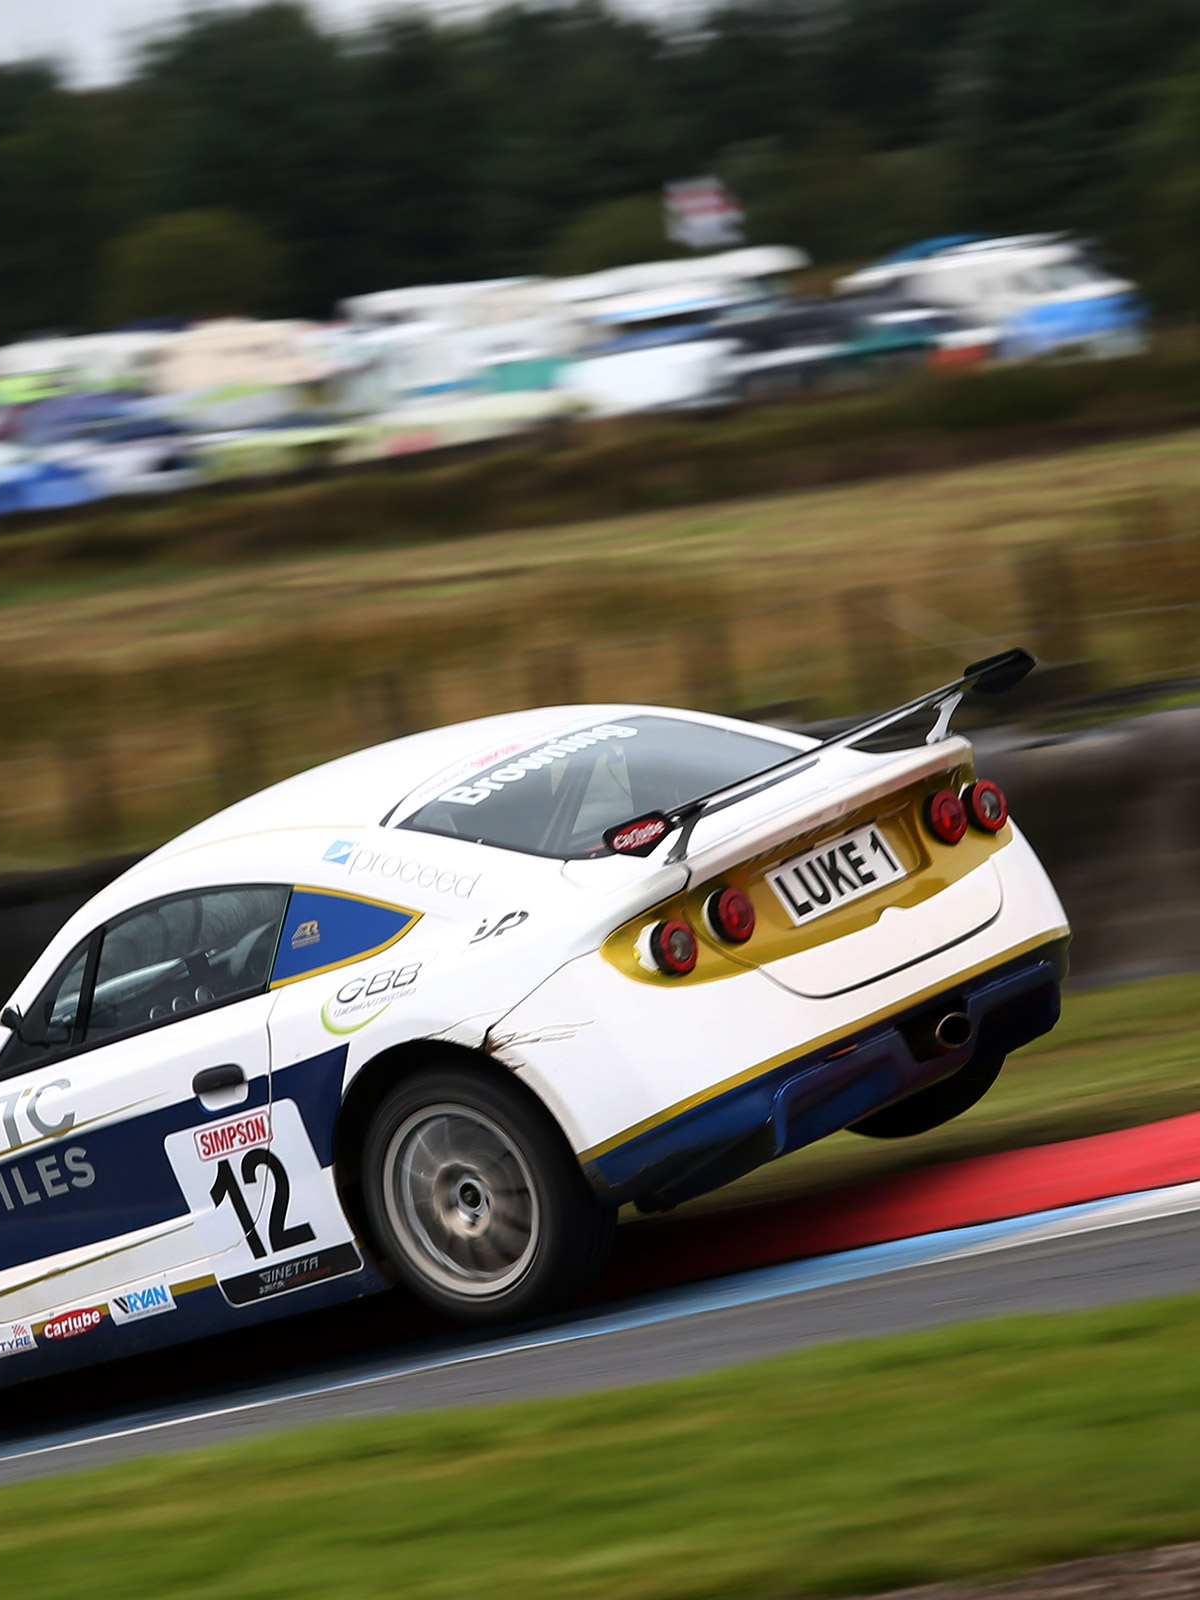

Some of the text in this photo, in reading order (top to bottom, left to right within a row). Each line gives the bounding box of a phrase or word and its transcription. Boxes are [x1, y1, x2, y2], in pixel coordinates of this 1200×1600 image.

[437, 724, 639, 806] Browning
[347, 848, 482, 899] proceed
[773, 829, 899, 918] LUKE 1
[336, 962, 423, 1003] GBB
[200, 1115, 267, 1157] SIMPSON
[209, 1148, 316, 1260] 12
[259, 1256, 319, 1283] GINETTA
[44, 1309, 101, 1339] Carlube
